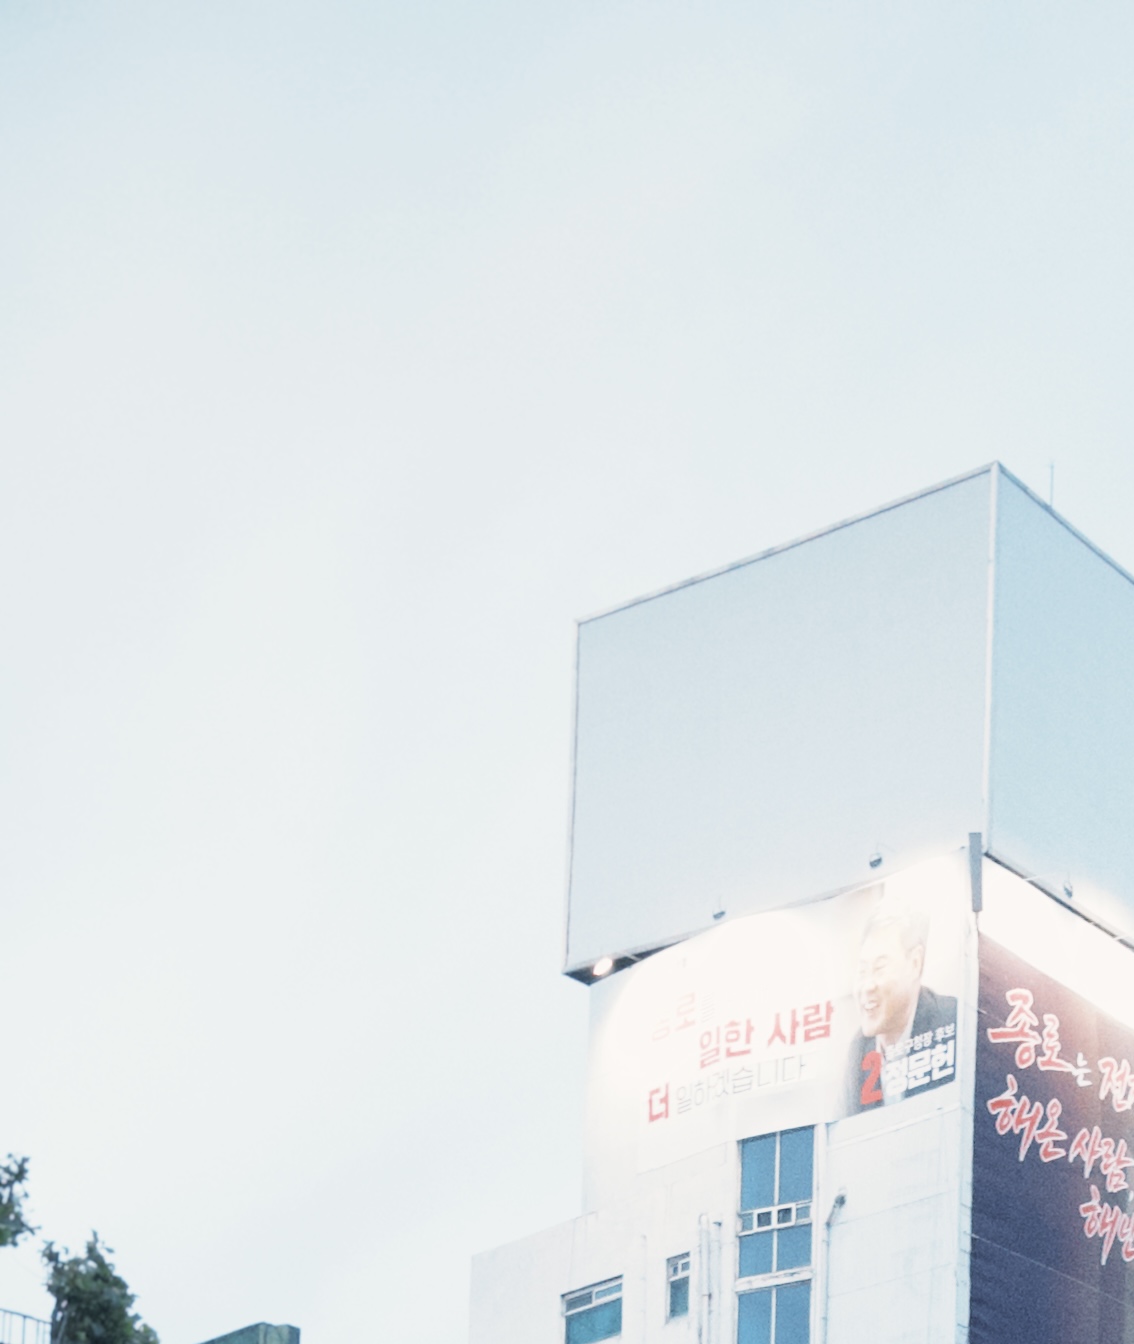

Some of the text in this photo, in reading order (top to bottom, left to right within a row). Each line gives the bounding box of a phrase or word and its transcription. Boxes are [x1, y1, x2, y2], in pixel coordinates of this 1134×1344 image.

[699, 999, 834, 1069] 일한 사람
[648, 1082, 671, 1124] 더
[859, 1050, 884, 1106] 2
